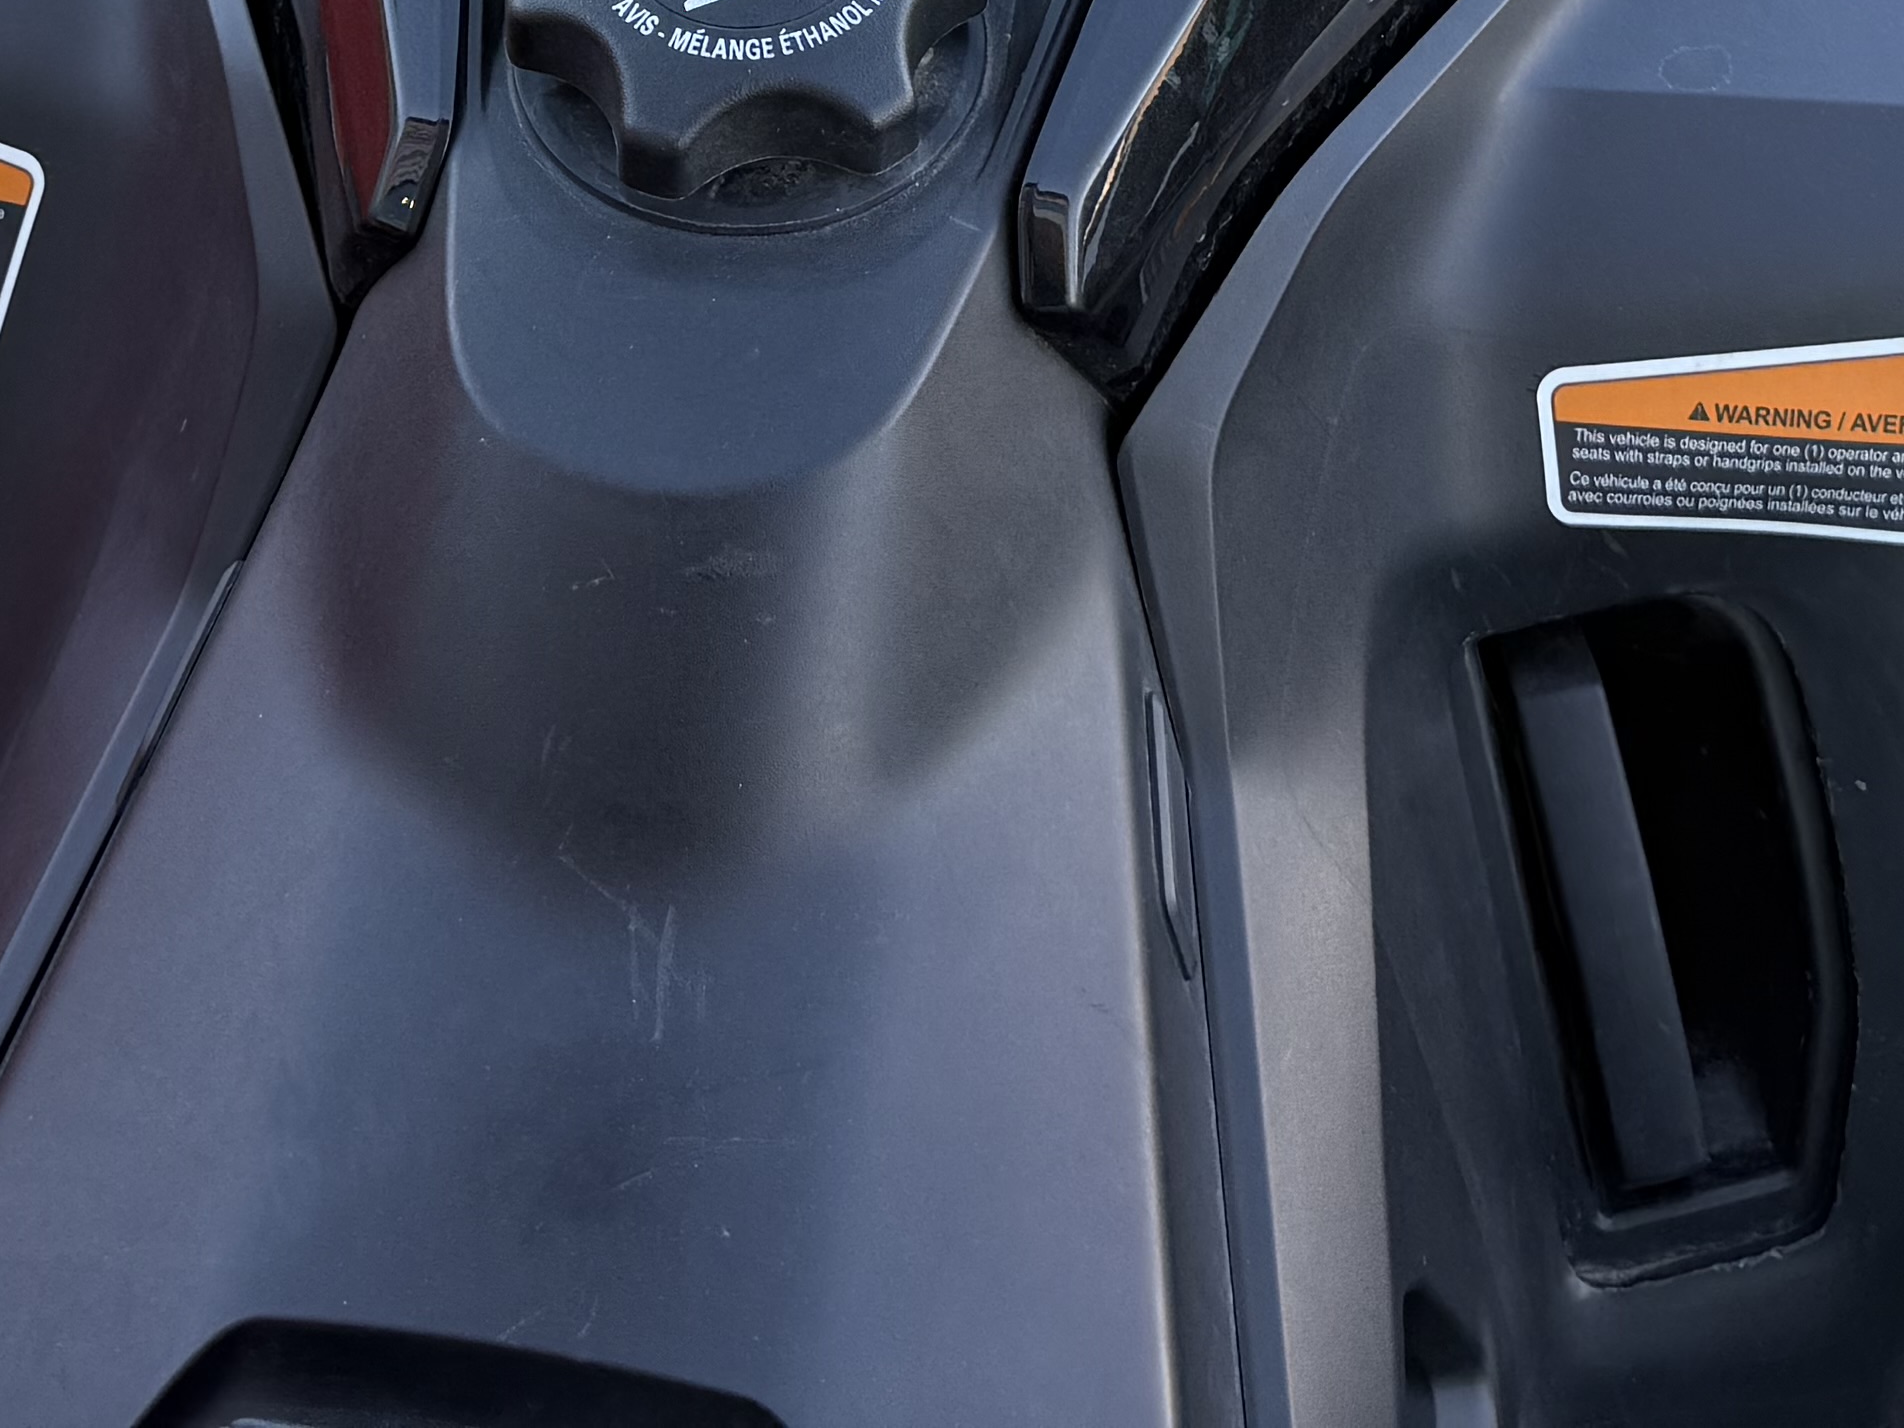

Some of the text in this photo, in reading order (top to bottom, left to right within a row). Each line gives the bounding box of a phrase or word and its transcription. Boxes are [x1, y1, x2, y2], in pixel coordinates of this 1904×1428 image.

[668, 29, 775, 61] MÉLANGE
[779, 0, 871, 57] ÉTHANOL
[1714, 402, 1833, 431] WARNING
[1572, 427, 1605, 442] This
[1608, 431, 1660, 447] vehicle
[1663, 435, 1676, 448] is
[1679, 436, 1746, 455] designed
[1749, 440, 1769, 455] for
[1772, 444, 1800, 456] one
[1803, 444, 1824, 459] (1)
[1827, 446, 1888, 462] operator
[1571, 446, 1611, 460] seats
[1613, 447, 1643, 462] with
[1645, 450, 1691, 467] straps
[1693, 456, 1710, 466] or
[1712, 455, 1782, 473] handgrips
[1785, 458, 1844, 475] installed
[1847, 464, 1865, 476] on
[1869, 465, 1892, 477] the
[1566, 490, 1603, 502] avec
[1606, 491, 1672, 506] courroies
[1676, 495, 1695, 507] ou
[1697, 495, 1764, 513] poignées
[1766, 499, 1835, 515] installées
[1838, 505, 1861, 516] sur
[1865, 506, 1878, 518] le
[1568, 470, 1590, 486] Ce
[1592, 472, 1649, 490] véhicule
[1652, 479, 1662, 489] a
[1664, 478, 1687, 491] été
[1689, 479, 1730, 495] conçu
[1733, 483, 1765, 497] pour
[1768, 484, 1785, 495] un
[1788, 483, 1808, 499] (1)
[1810, 486, 1887, 503] conducteur
[1889, 492, 1904, 505] et
